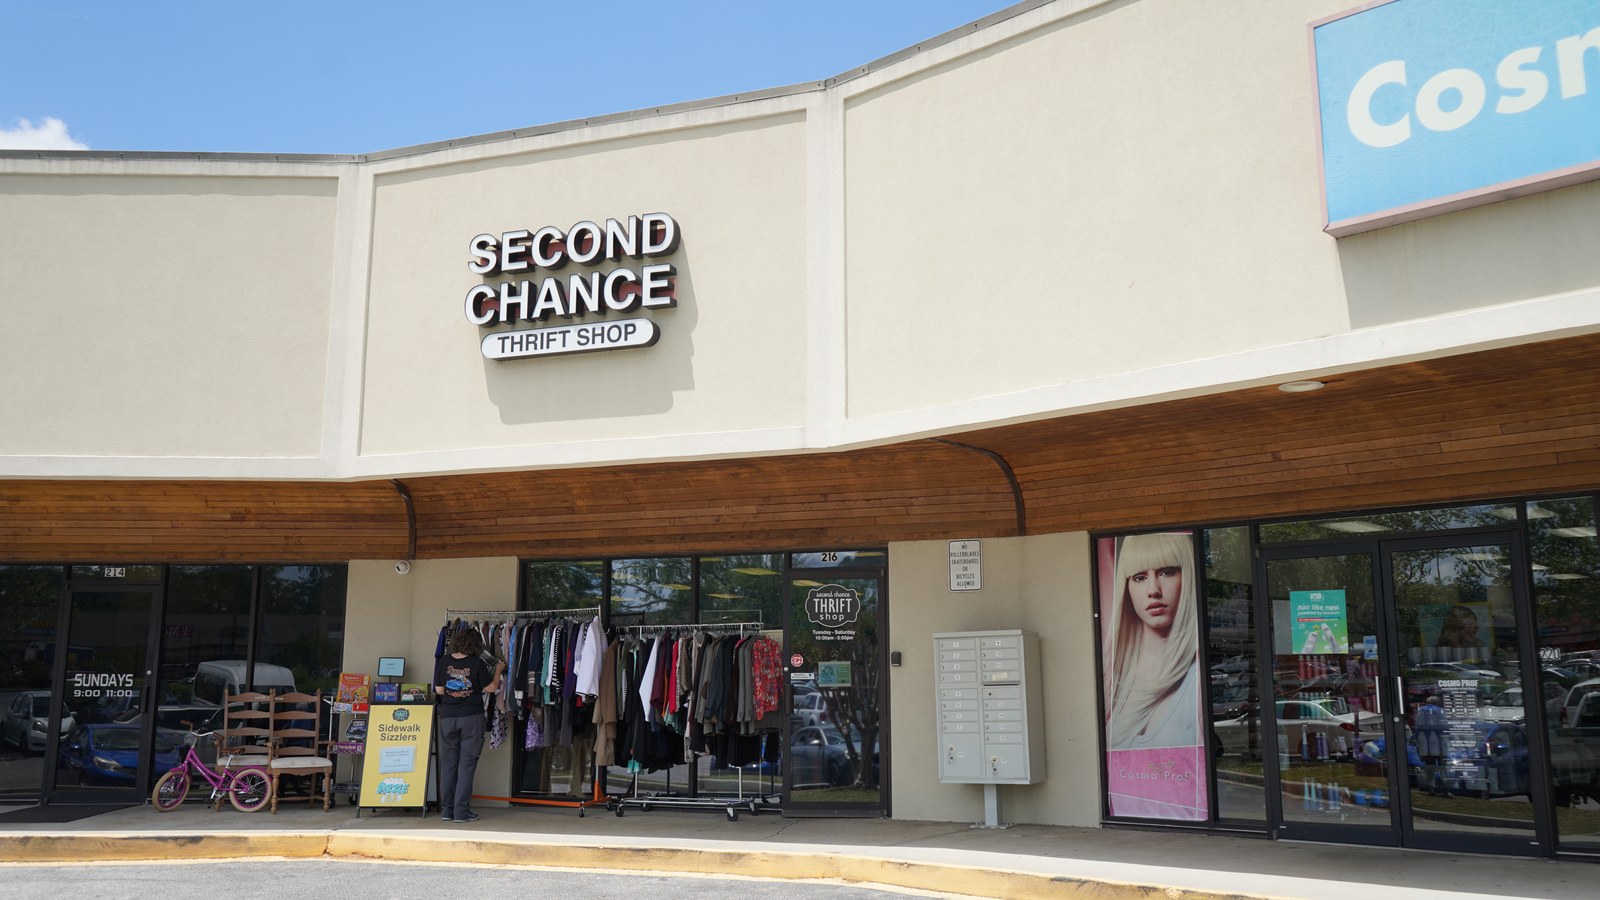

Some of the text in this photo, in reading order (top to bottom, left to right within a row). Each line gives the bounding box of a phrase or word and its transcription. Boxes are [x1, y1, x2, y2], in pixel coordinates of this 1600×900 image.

[467, 212, 679, 276] SECOND
[464, 263, 675, 326] CHANCE
[497, 323, 637, 354] THRIFT SHOP
[821, 552, 838, 562] 216
[106, 568, 125, 577] 214
[813, 598, 852, 613] THRIFT
[819, 613, 845, 622] shop
[74, 673, 134, 687] SUNDAYS
[1438, 679, 1479, 687] COSMO PROF
[73, 689, 133, 698] 9:00 11:00
[378, 723, 421, 732] Sidewalk
[380, 733, 417, 741] Sizzlers
[1120, 768, 1189, 782] Cosmo Prof
